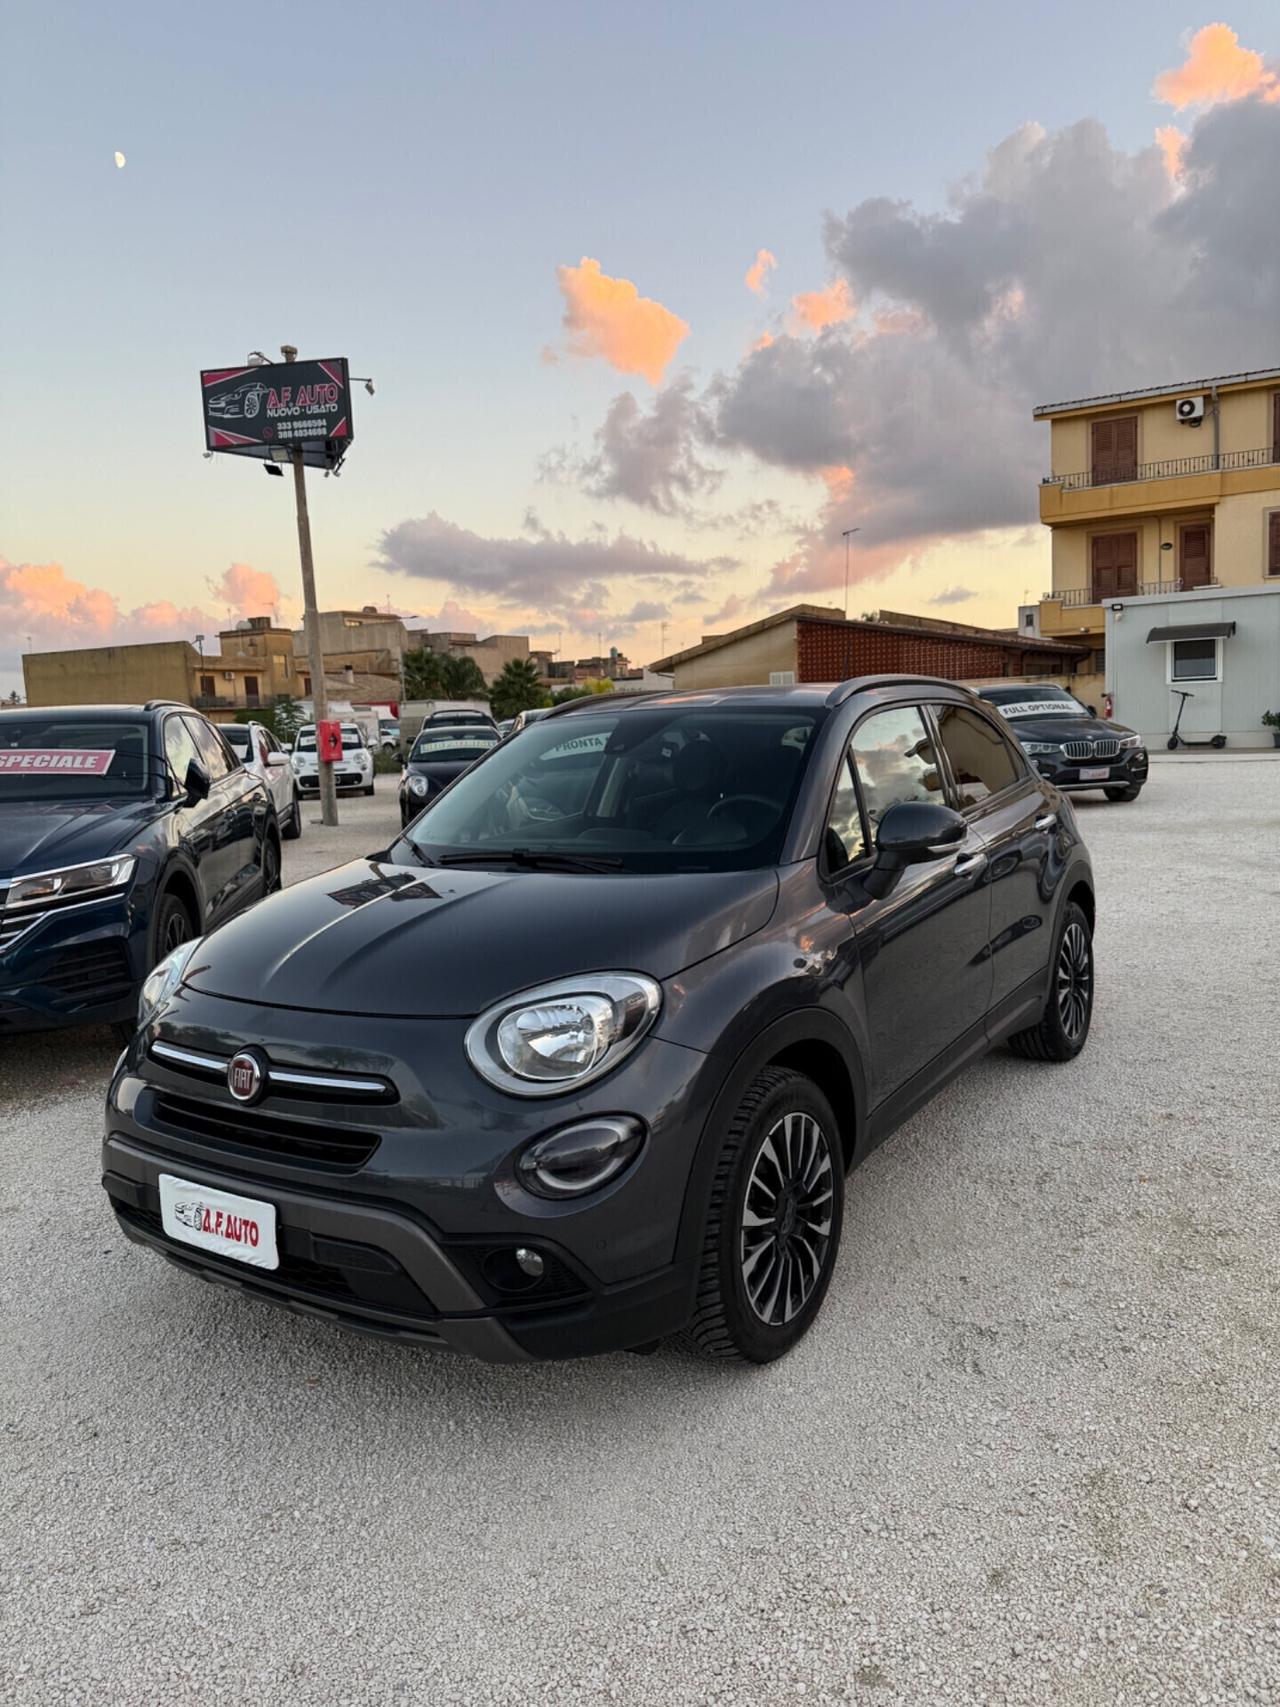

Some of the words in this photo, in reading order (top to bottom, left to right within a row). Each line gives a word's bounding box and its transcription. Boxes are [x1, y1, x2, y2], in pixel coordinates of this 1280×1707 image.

[296, 383, 338, 406] AUTO
[267, 406, 300, 418] NUOVO
[306, 403, 338, 414] USATO
[1003, 706, 1027, 715] FULL
[1030, 703, 1073, 713] OPTIONAL
[554, 737, 603, 752] PRONTA
[0, 754, 99, 769] SPECIALE
[234, 1067, 252, 1089] FIAT
